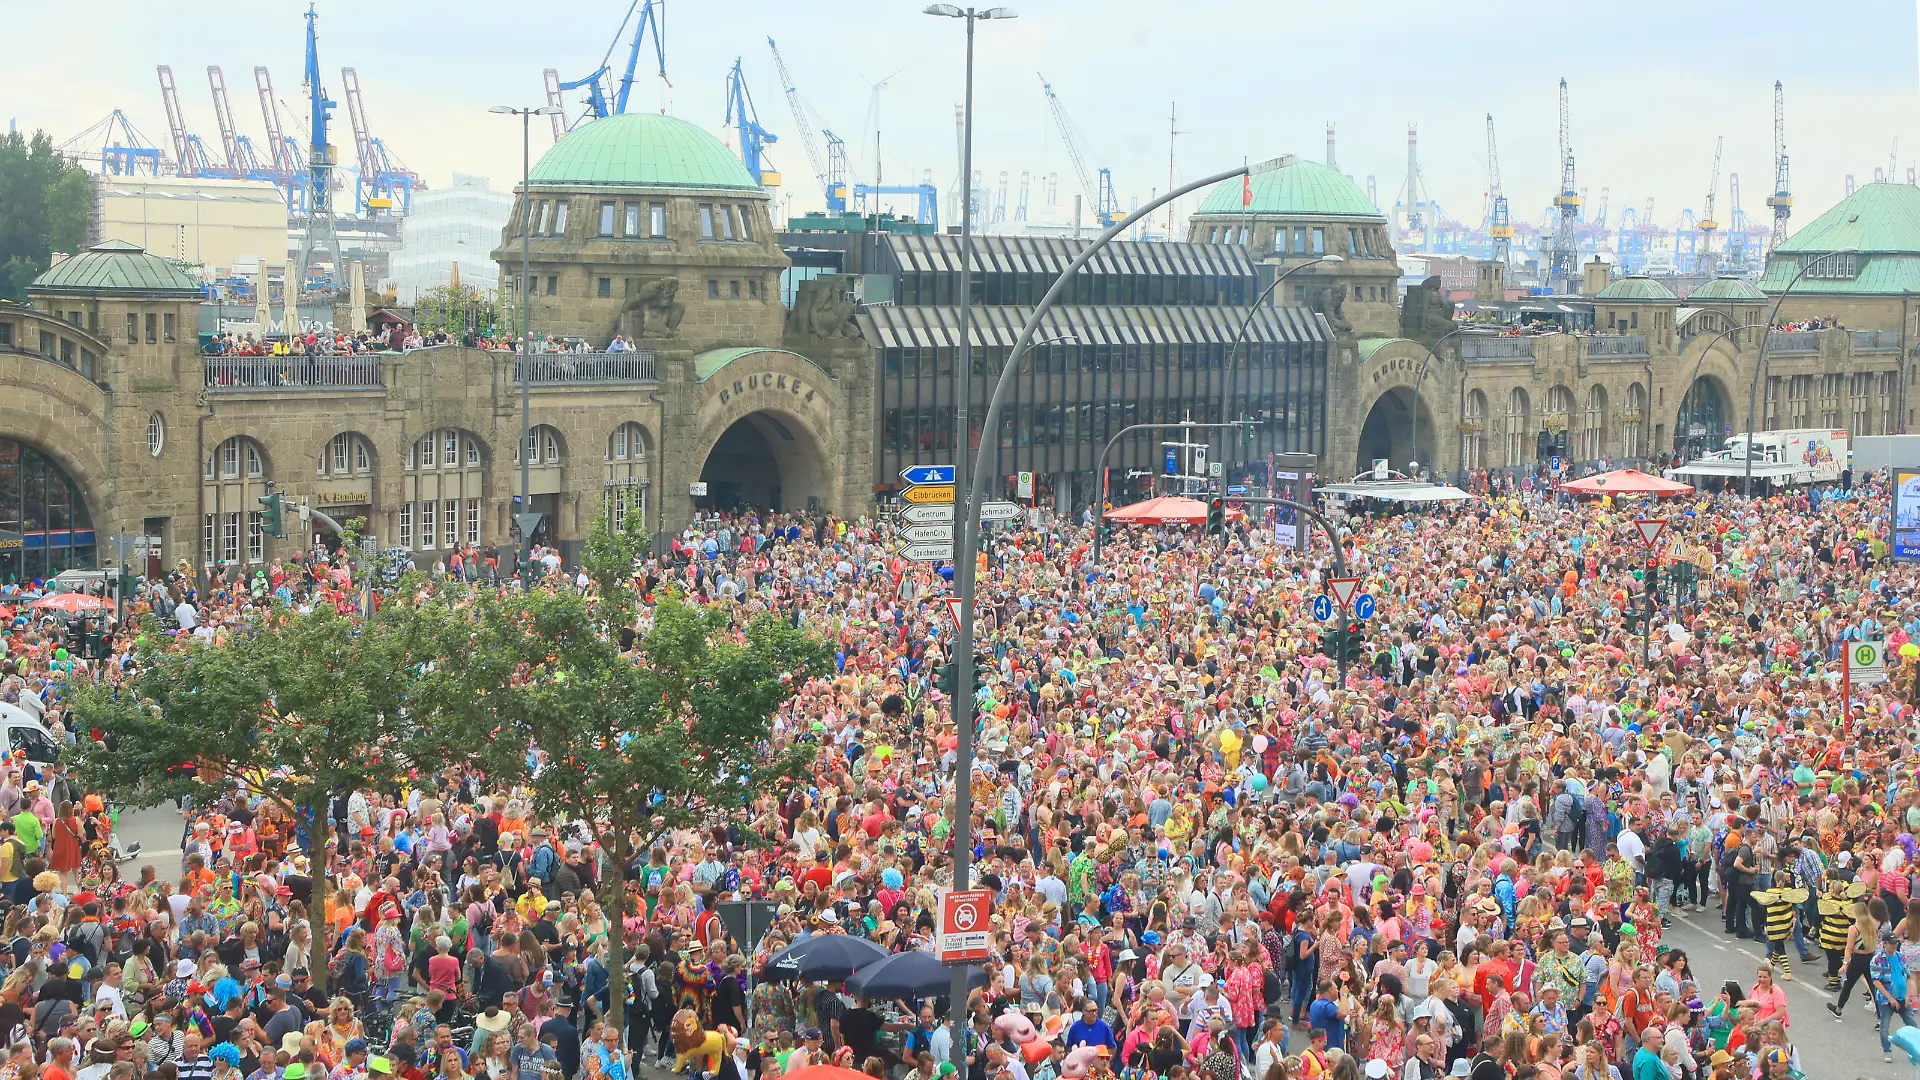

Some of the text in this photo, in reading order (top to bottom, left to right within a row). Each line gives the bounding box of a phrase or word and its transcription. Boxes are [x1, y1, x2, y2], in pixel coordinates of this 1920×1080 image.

[917, 510, 946, 518] Centrum
[914, 529, 947, 538] HafenCity
[913, 549, 948, 558] Speicherstadt
